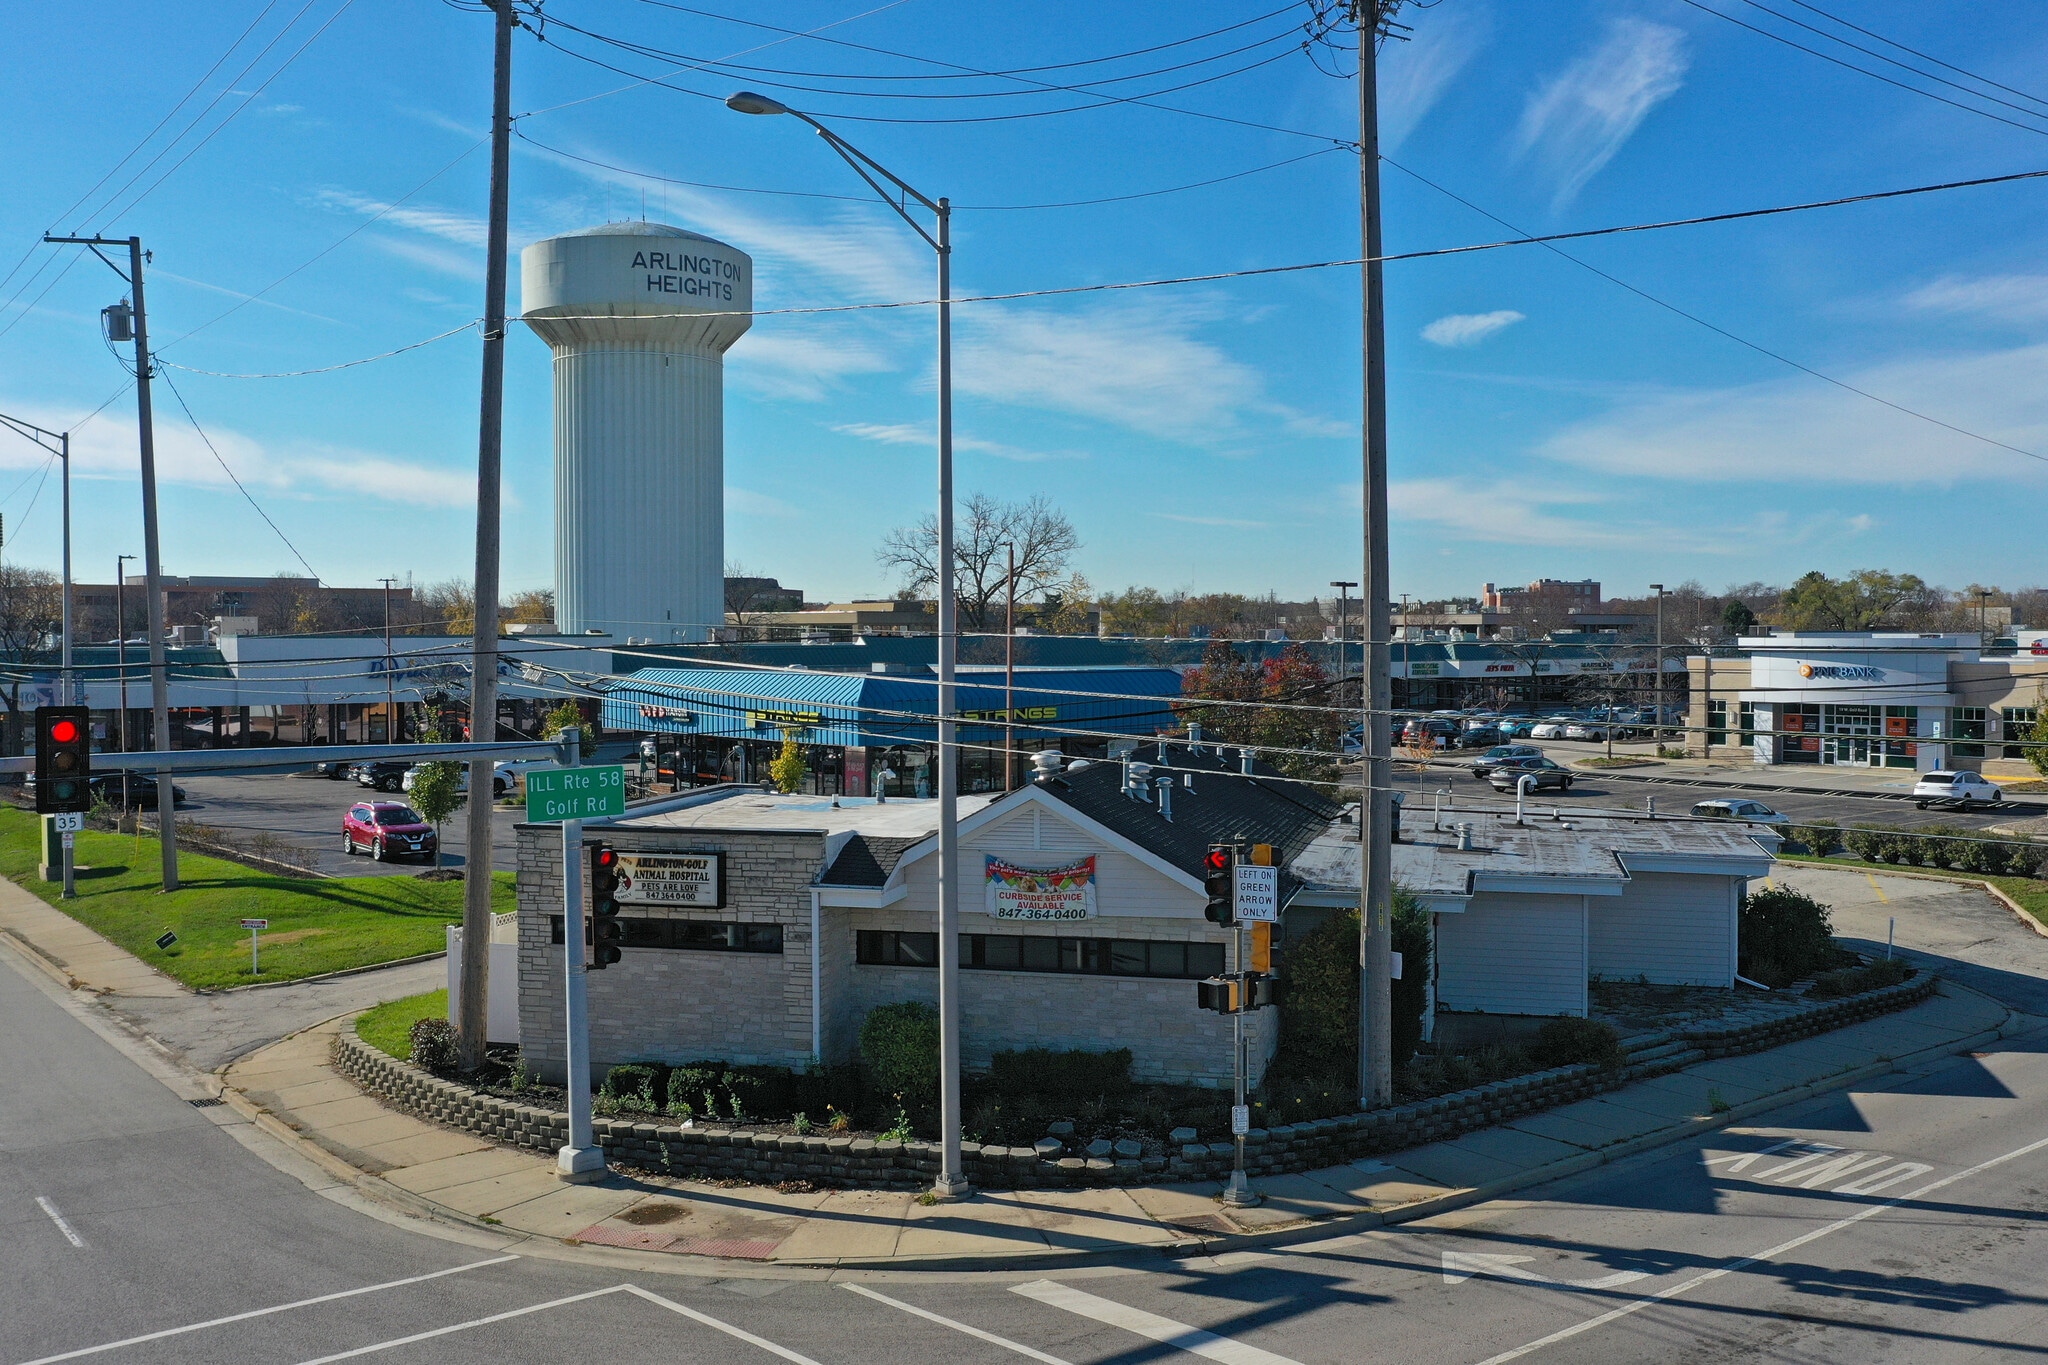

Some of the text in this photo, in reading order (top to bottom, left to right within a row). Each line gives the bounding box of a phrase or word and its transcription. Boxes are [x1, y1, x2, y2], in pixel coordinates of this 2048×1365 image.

[631, 251, 741, 282] ARLINGTON
[647, 274, 733, 301] HEIGHTS
[964, 707, 1057, 720] STRNGS
[530, 771, 620, 792] ILL Rte 58
[546, 797, 607, 815] Golf Rd
[58, 817, 77, 829] 35
[636, 857, 709, 870] ARLINGTON-GOLF
[633, 870, 710, 881] ANIMAL HOSPITAL
[1239, 870, 1272, 879] LEFT ON
[641, 882, 660, 890] PETS
[663, 883, 678, 891] ARE
[1240, 882, 1270, 892] GREEN
[676, 892, 696, 900] 0400
[999, 892, 1082, 902] CURBSIDE SERVICE
[1239, 895, 1272, 904] ARROW
[1017, 902, 1065, 910] AVAILABLE
[1243, 907, 1267, 916] ONLY
[998, 908, 1086, 919] 847-364-0400
